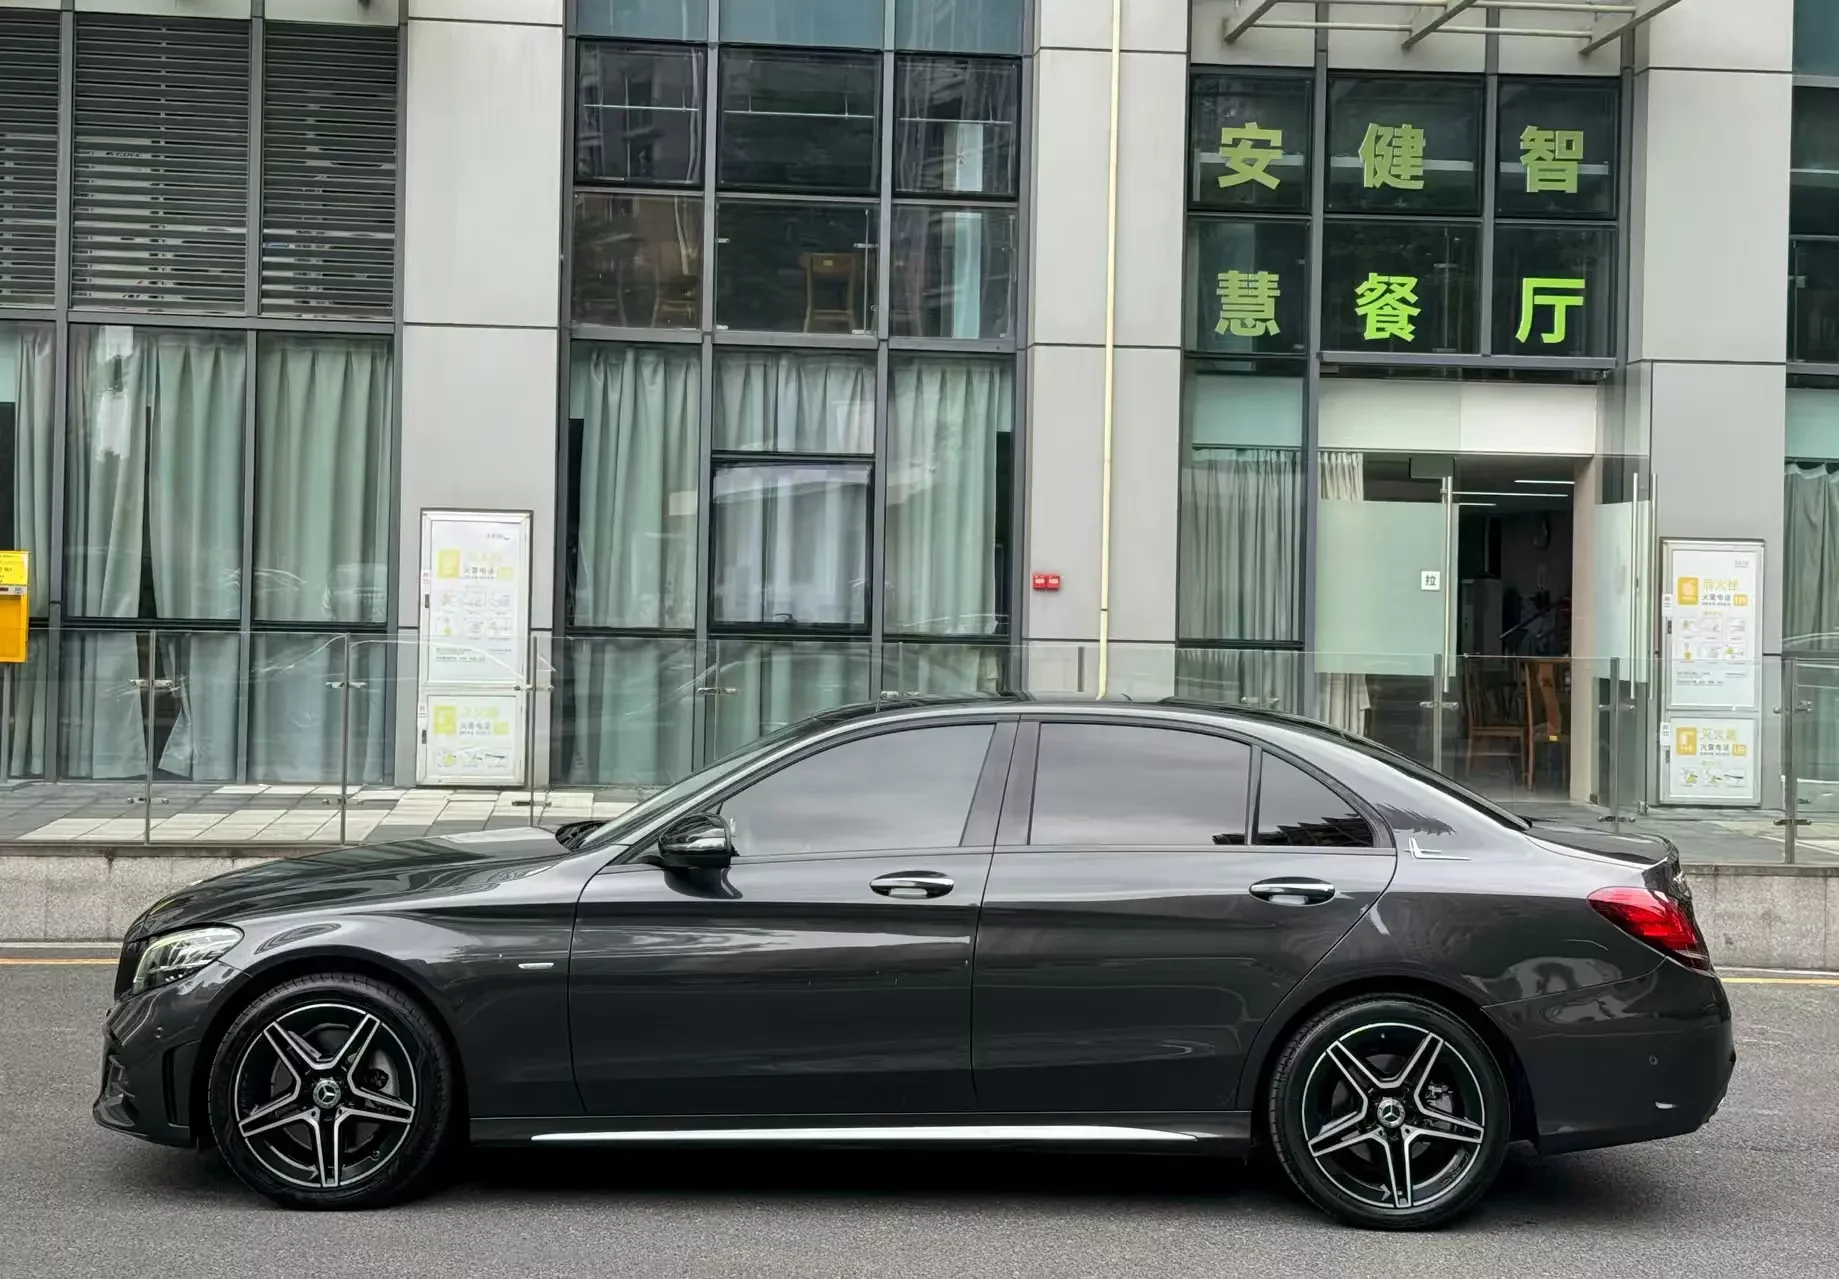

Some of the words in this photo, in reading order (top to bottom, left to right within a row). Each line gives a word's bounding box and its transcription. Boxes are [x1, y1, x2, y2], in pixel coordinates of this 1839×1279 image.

[1217, 121, 1585, 194] 安健智
[1214, 270, 1587, 344] 慧餐厅
[1424, 575, 1437, 586] 拉
